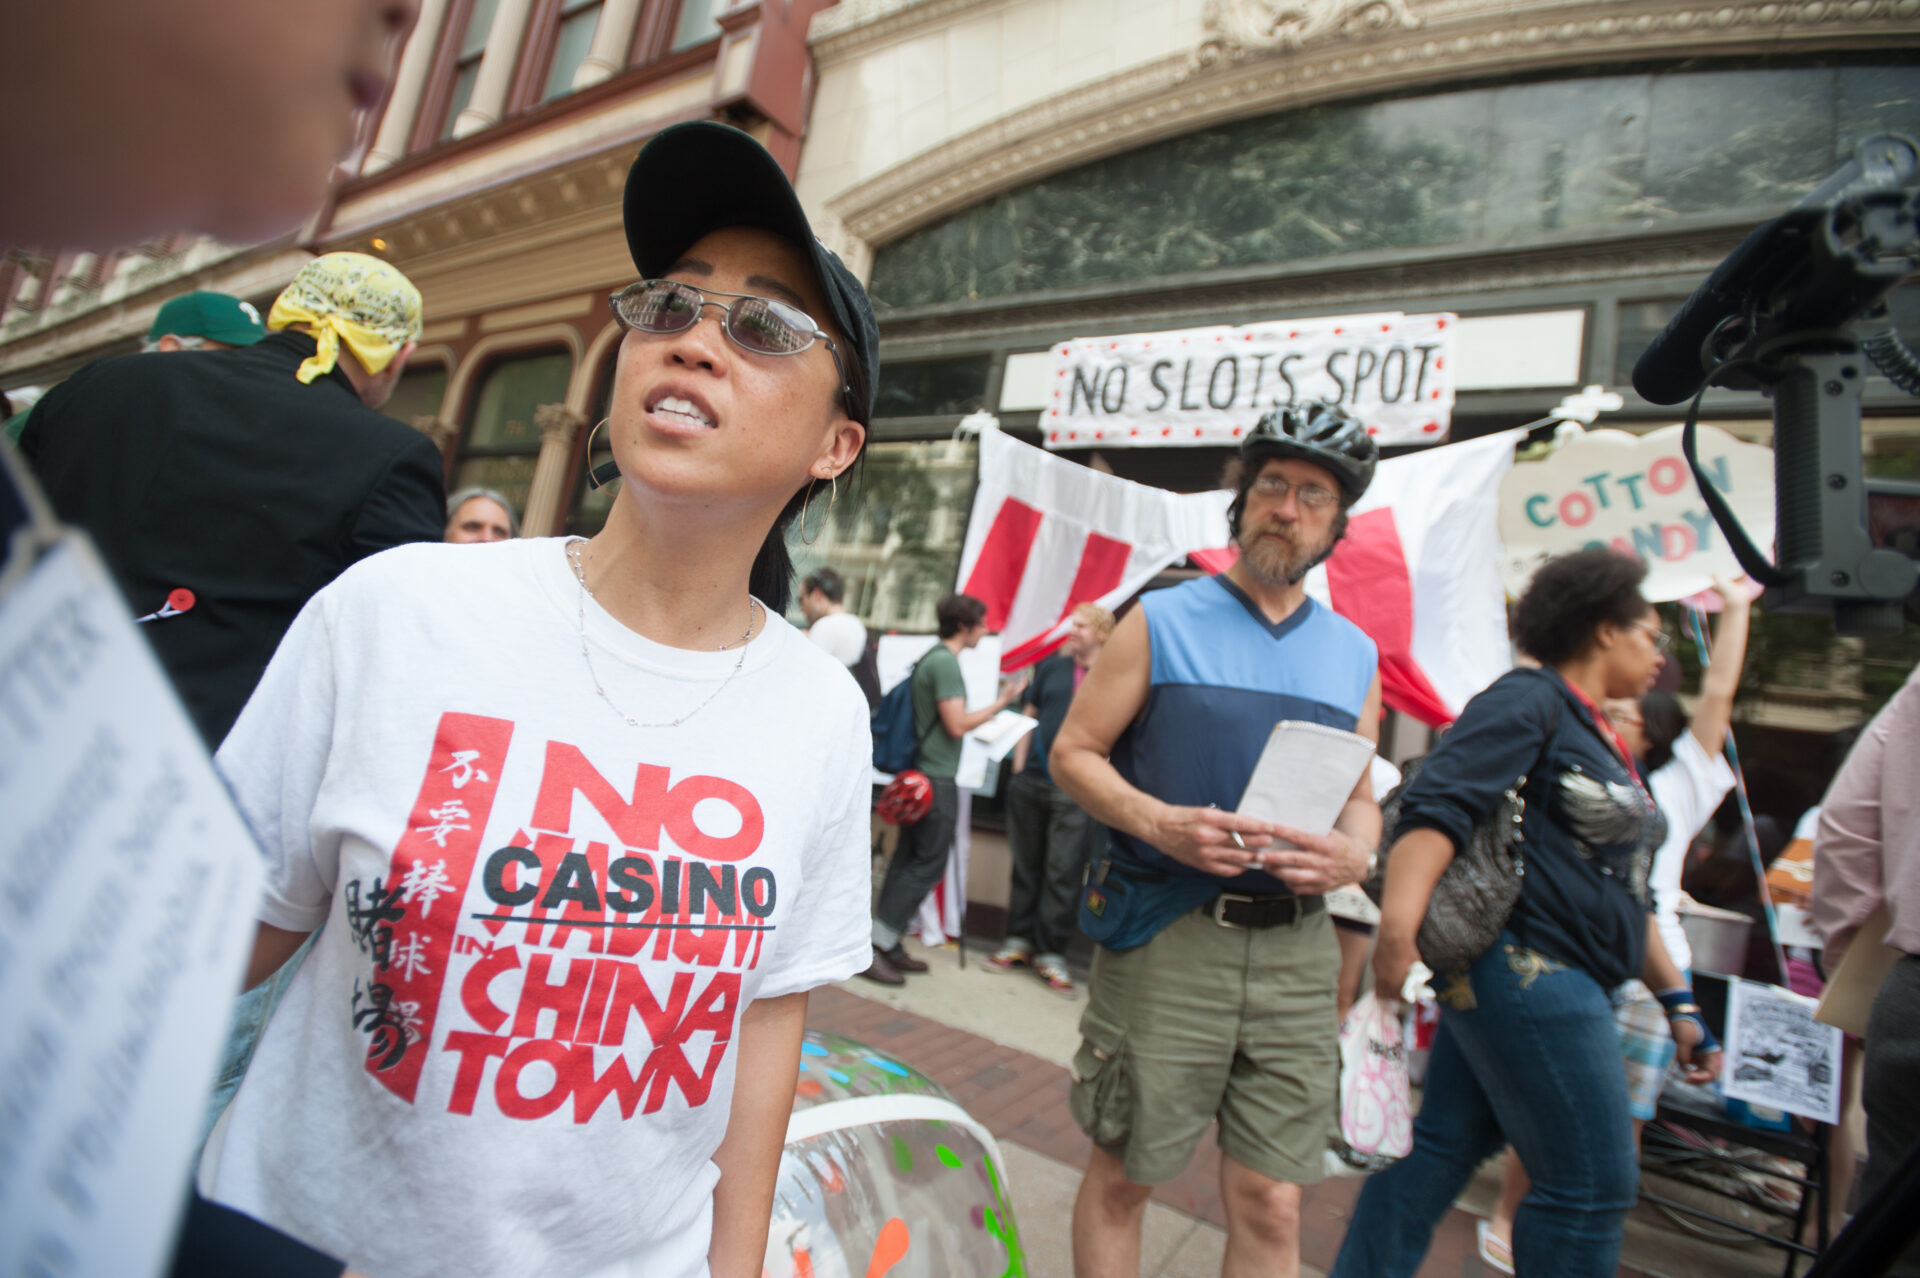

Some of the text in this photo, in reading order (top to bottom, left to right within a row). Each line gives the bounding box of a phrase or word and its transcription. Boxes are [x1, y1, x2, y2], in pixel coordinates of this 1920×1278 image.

[1068, 343, 1441, 416] NO SLOTS SPOT
[1582, 509, 1714, 563] ANDY
[530, 740, 765, 862] NO
[482, 846, 777, 918] CASINO
[453, 933, 495, 959] IN
[460, 944, 742, 1048] CHINA
[442, 1030, 729, 1125] TOWN
